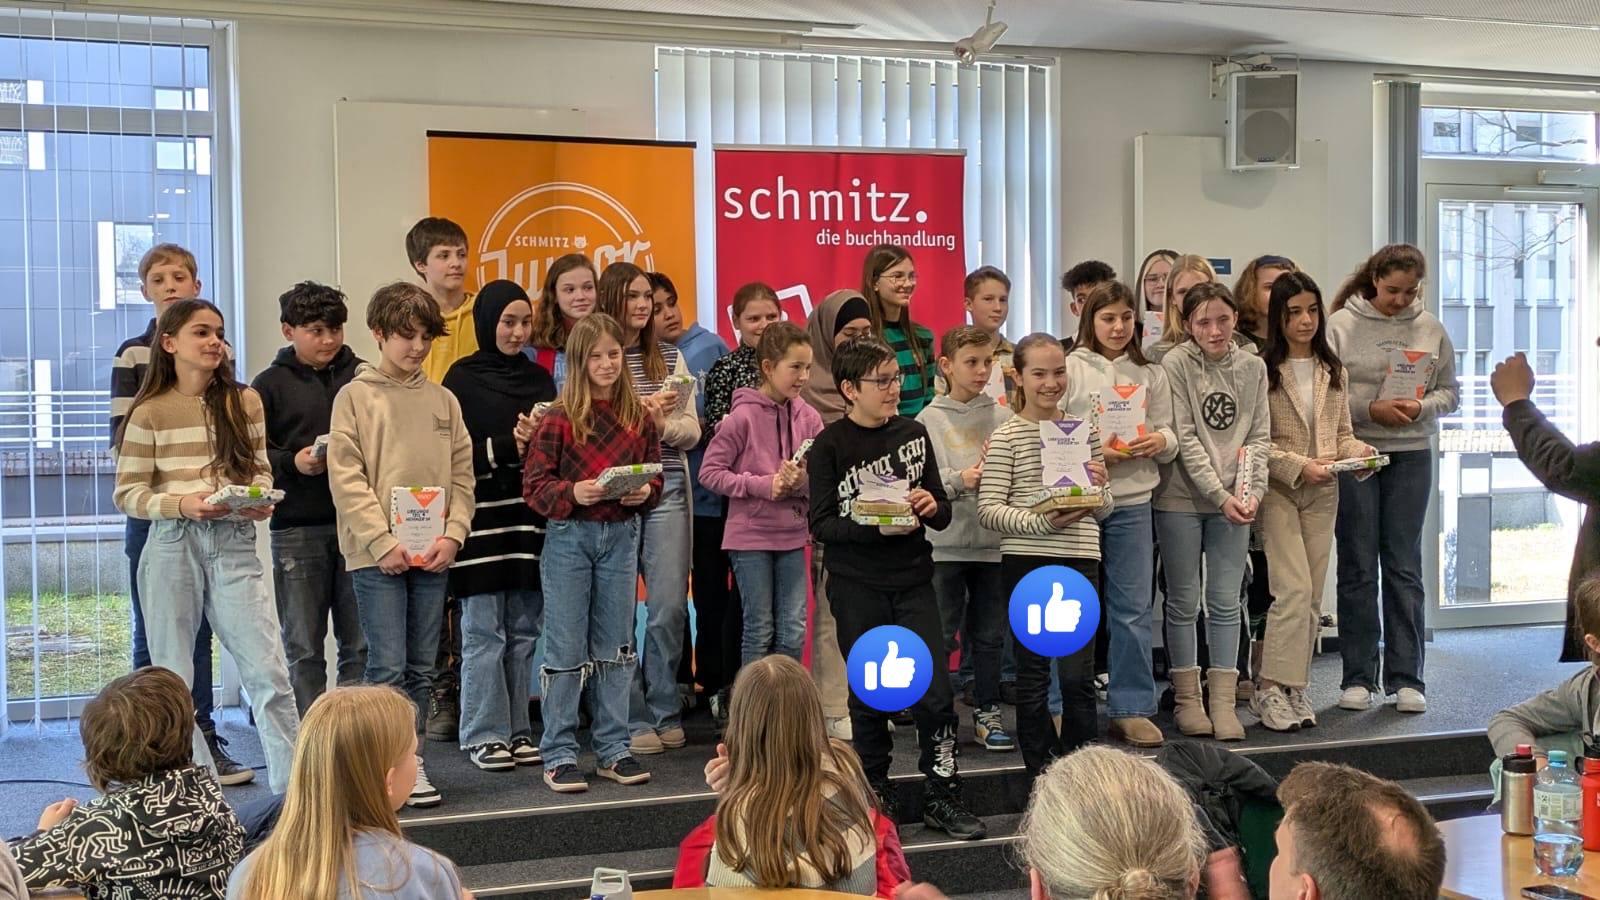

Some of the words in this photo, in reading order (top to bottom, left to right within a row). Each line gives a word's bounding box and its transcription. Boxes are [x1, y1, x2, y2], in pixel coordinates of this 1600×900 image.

[723, 175, 928, 224] schmitz.
[514, 235, 570, 249] SCHMITZ
[815, 229, 841, 246] die
[845, 229, 956, 251] buchhandlung
